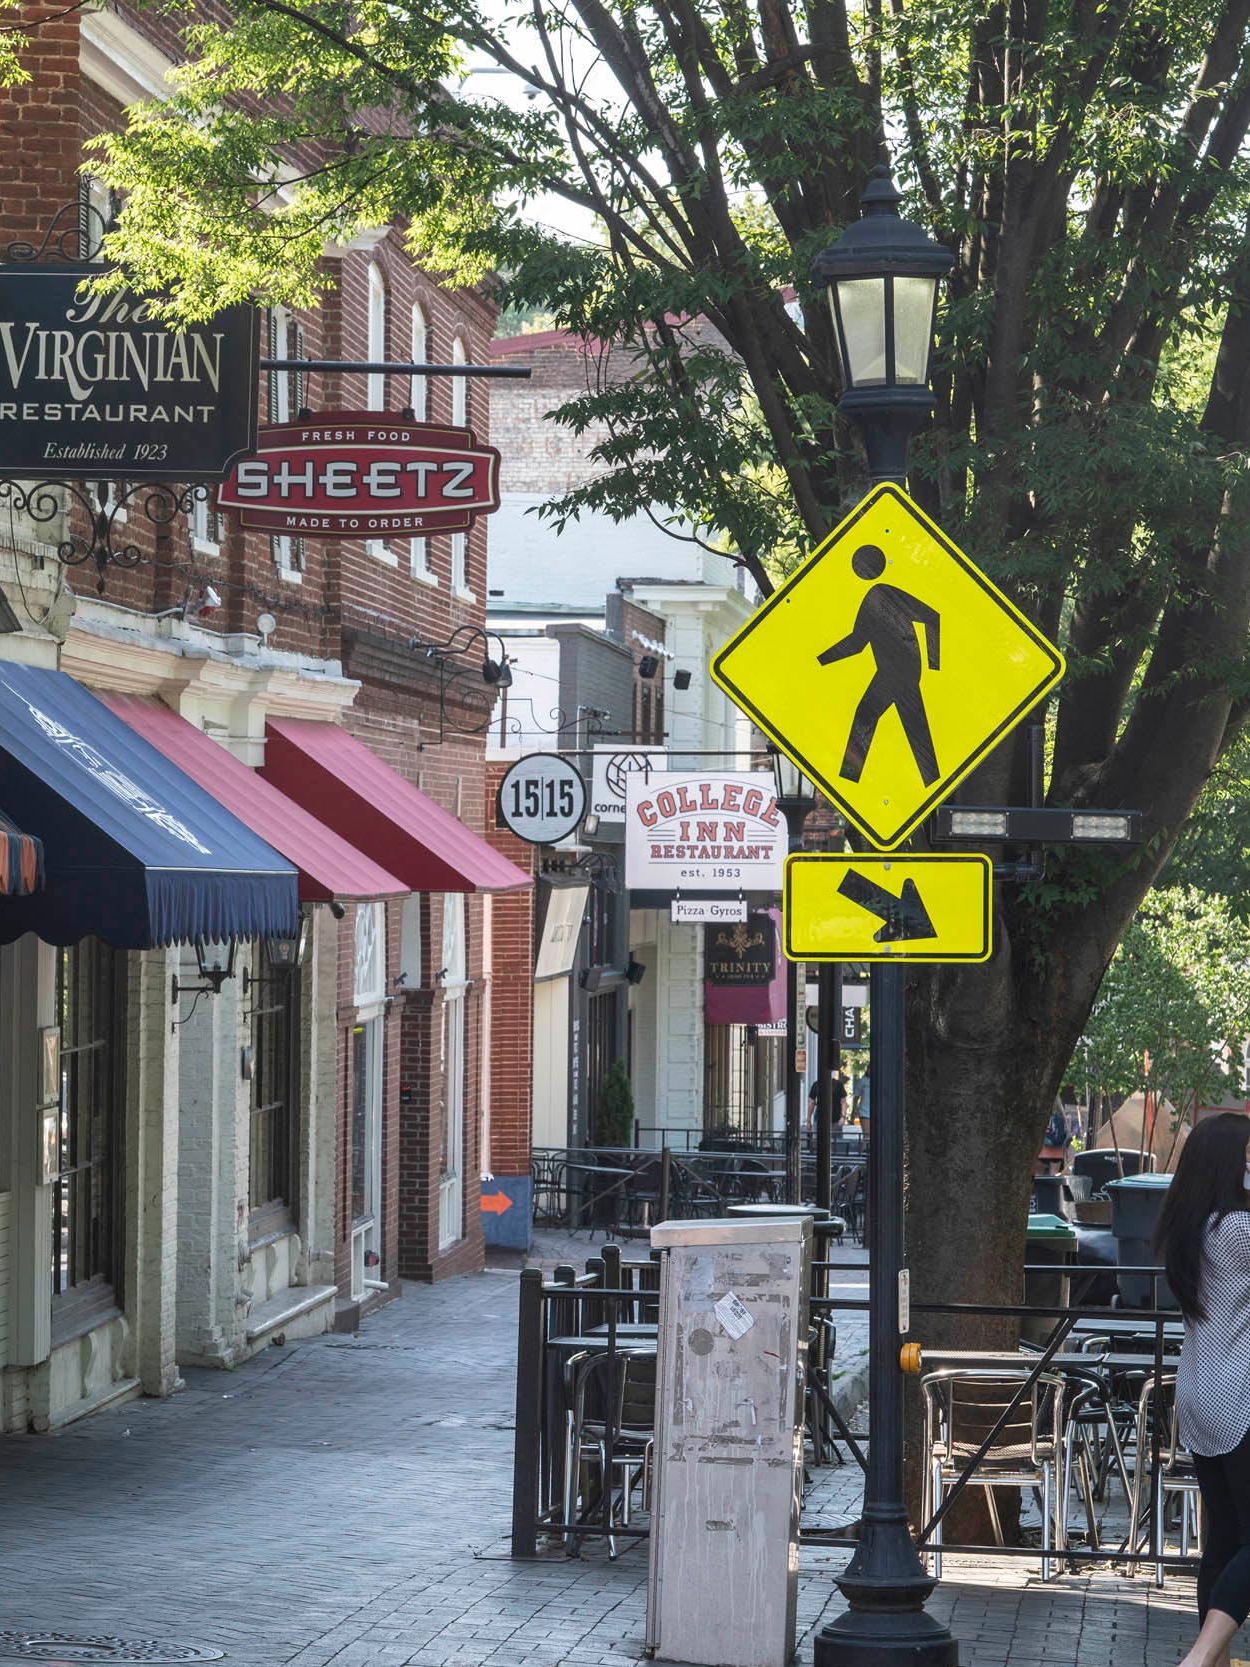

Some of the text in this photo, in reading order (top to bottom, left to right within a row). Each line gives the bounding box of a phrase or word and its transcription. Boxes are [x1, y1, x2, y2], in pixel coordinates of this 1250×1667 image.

[0, 402, 216, 424] RESTAURANT
[302, 430, 411, 442] FRESH FOOD
[43, 442, 169, 461] Established 1923
[237, 461, 475, 499] SHEETZ
[286, 515, 424, 529] MADE TO ORDER
[636, 783, 780, 828] COLLEGE
[679, 821, 746, 842] INN
[650, 845, 774, 860] RESTAURANT
[680, 867, 741, 878] est. 1953
[677, 905, 743, 919] Pizza Gyros
[710, 962, 771, 974] TRINITY
